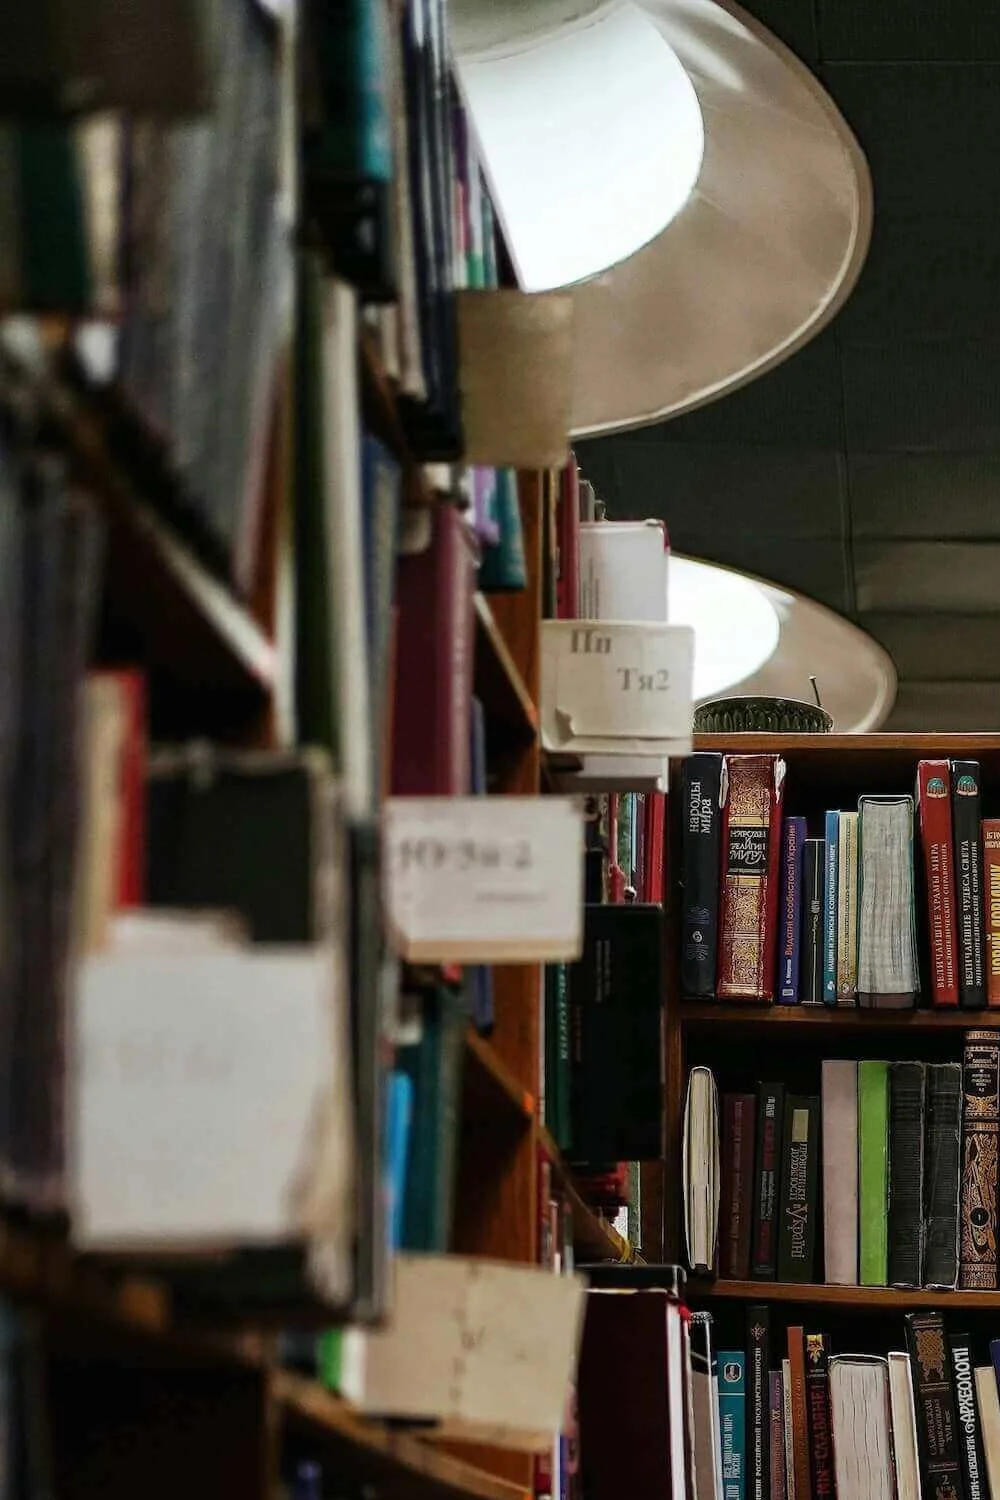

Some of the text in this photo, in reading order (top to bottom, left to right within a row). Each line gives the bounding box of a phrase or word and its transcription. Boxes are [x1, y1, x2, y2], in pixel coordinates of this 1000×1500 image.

[617, 667, 670, 690] Тя2
[688, 782, 702, 832] народы
[699, 798, 712, 833] мира
[931, 843, 945, 988] ВЕЛИЧАЙШИЕ ХРАМЫ МИРА
[942, 843, 953, 988] ЭНЦИКЛОПЕДИЧЕСКИЙ СПРАВОЧНИК
[961, 840, 973, 986] ВЕЛИЧАЙШИЕ ЧУДЕСА СВЕТА
[971, 841, 982, 987] ЭНЦИКЛОПЕДИЧЕСКИЙ СПРАВОЧНИК
[754, 1347, 762, 1425] ГОСУДАРСТВЕННОСТИ
[722, 1414, 732, 1432] МИРА
[723, 1434, 733, 1464] МОНАРХИ
[754, 1428, 762, 1476] РОССИЙСКОЙ
